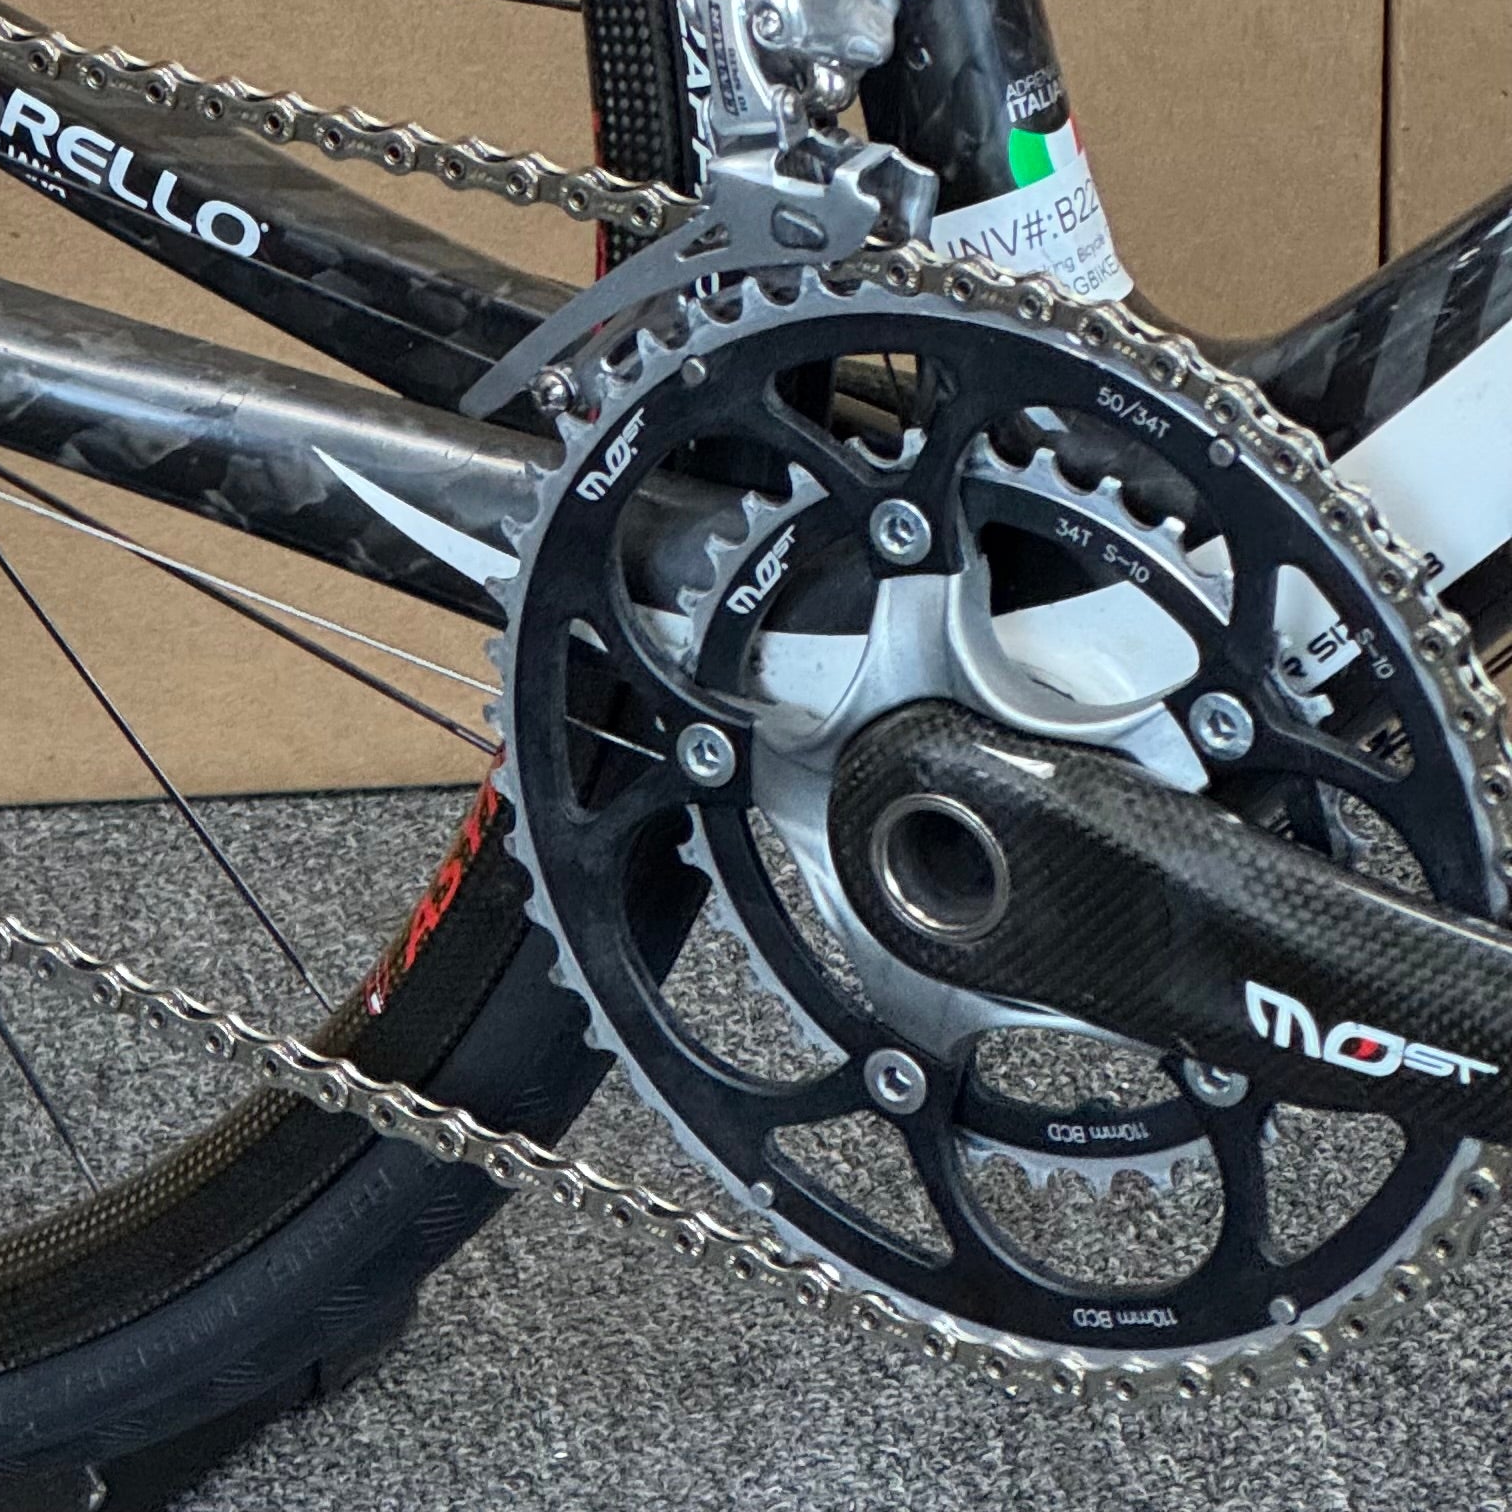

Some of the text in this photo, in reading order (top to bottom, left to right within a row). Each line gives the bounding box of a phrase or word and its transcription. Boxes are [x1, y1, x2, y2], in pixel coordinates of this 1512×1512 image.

[1095, 387, 1171, 440] 50/34T
[1055, 517, 1151, 584] 34T S-10
[1357, 627, 1396, 680] S-10
[1047, 1122, 1086, 1144] BCD
[1073, 1307, 1114, 1329] BCD
